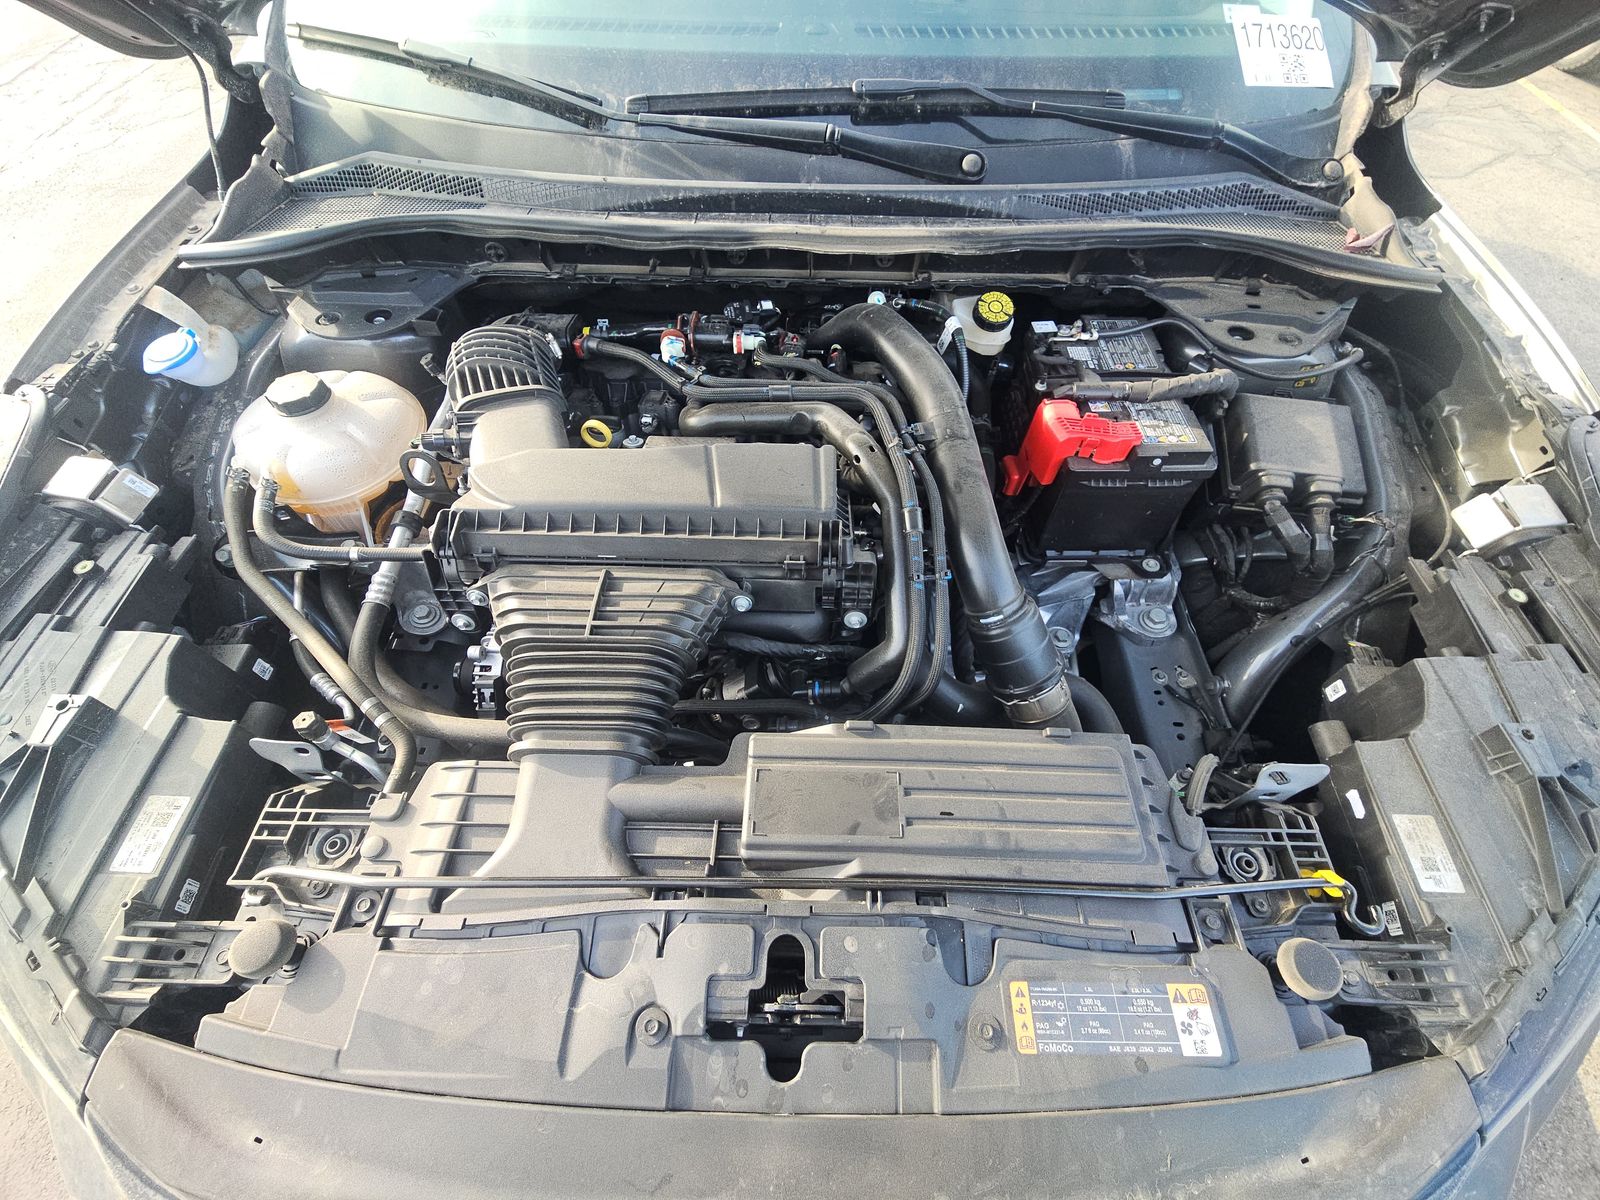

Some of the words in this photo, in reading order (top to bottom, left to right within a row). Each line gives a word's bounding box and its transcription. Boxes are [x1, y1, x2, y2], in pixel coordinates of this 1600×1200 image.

[1240, 22, 1325, 51] 1713620
[1031, 999, 1057, 1008] R-1234yf
[1039, 1044, 1074, 1053] FoMoCo
